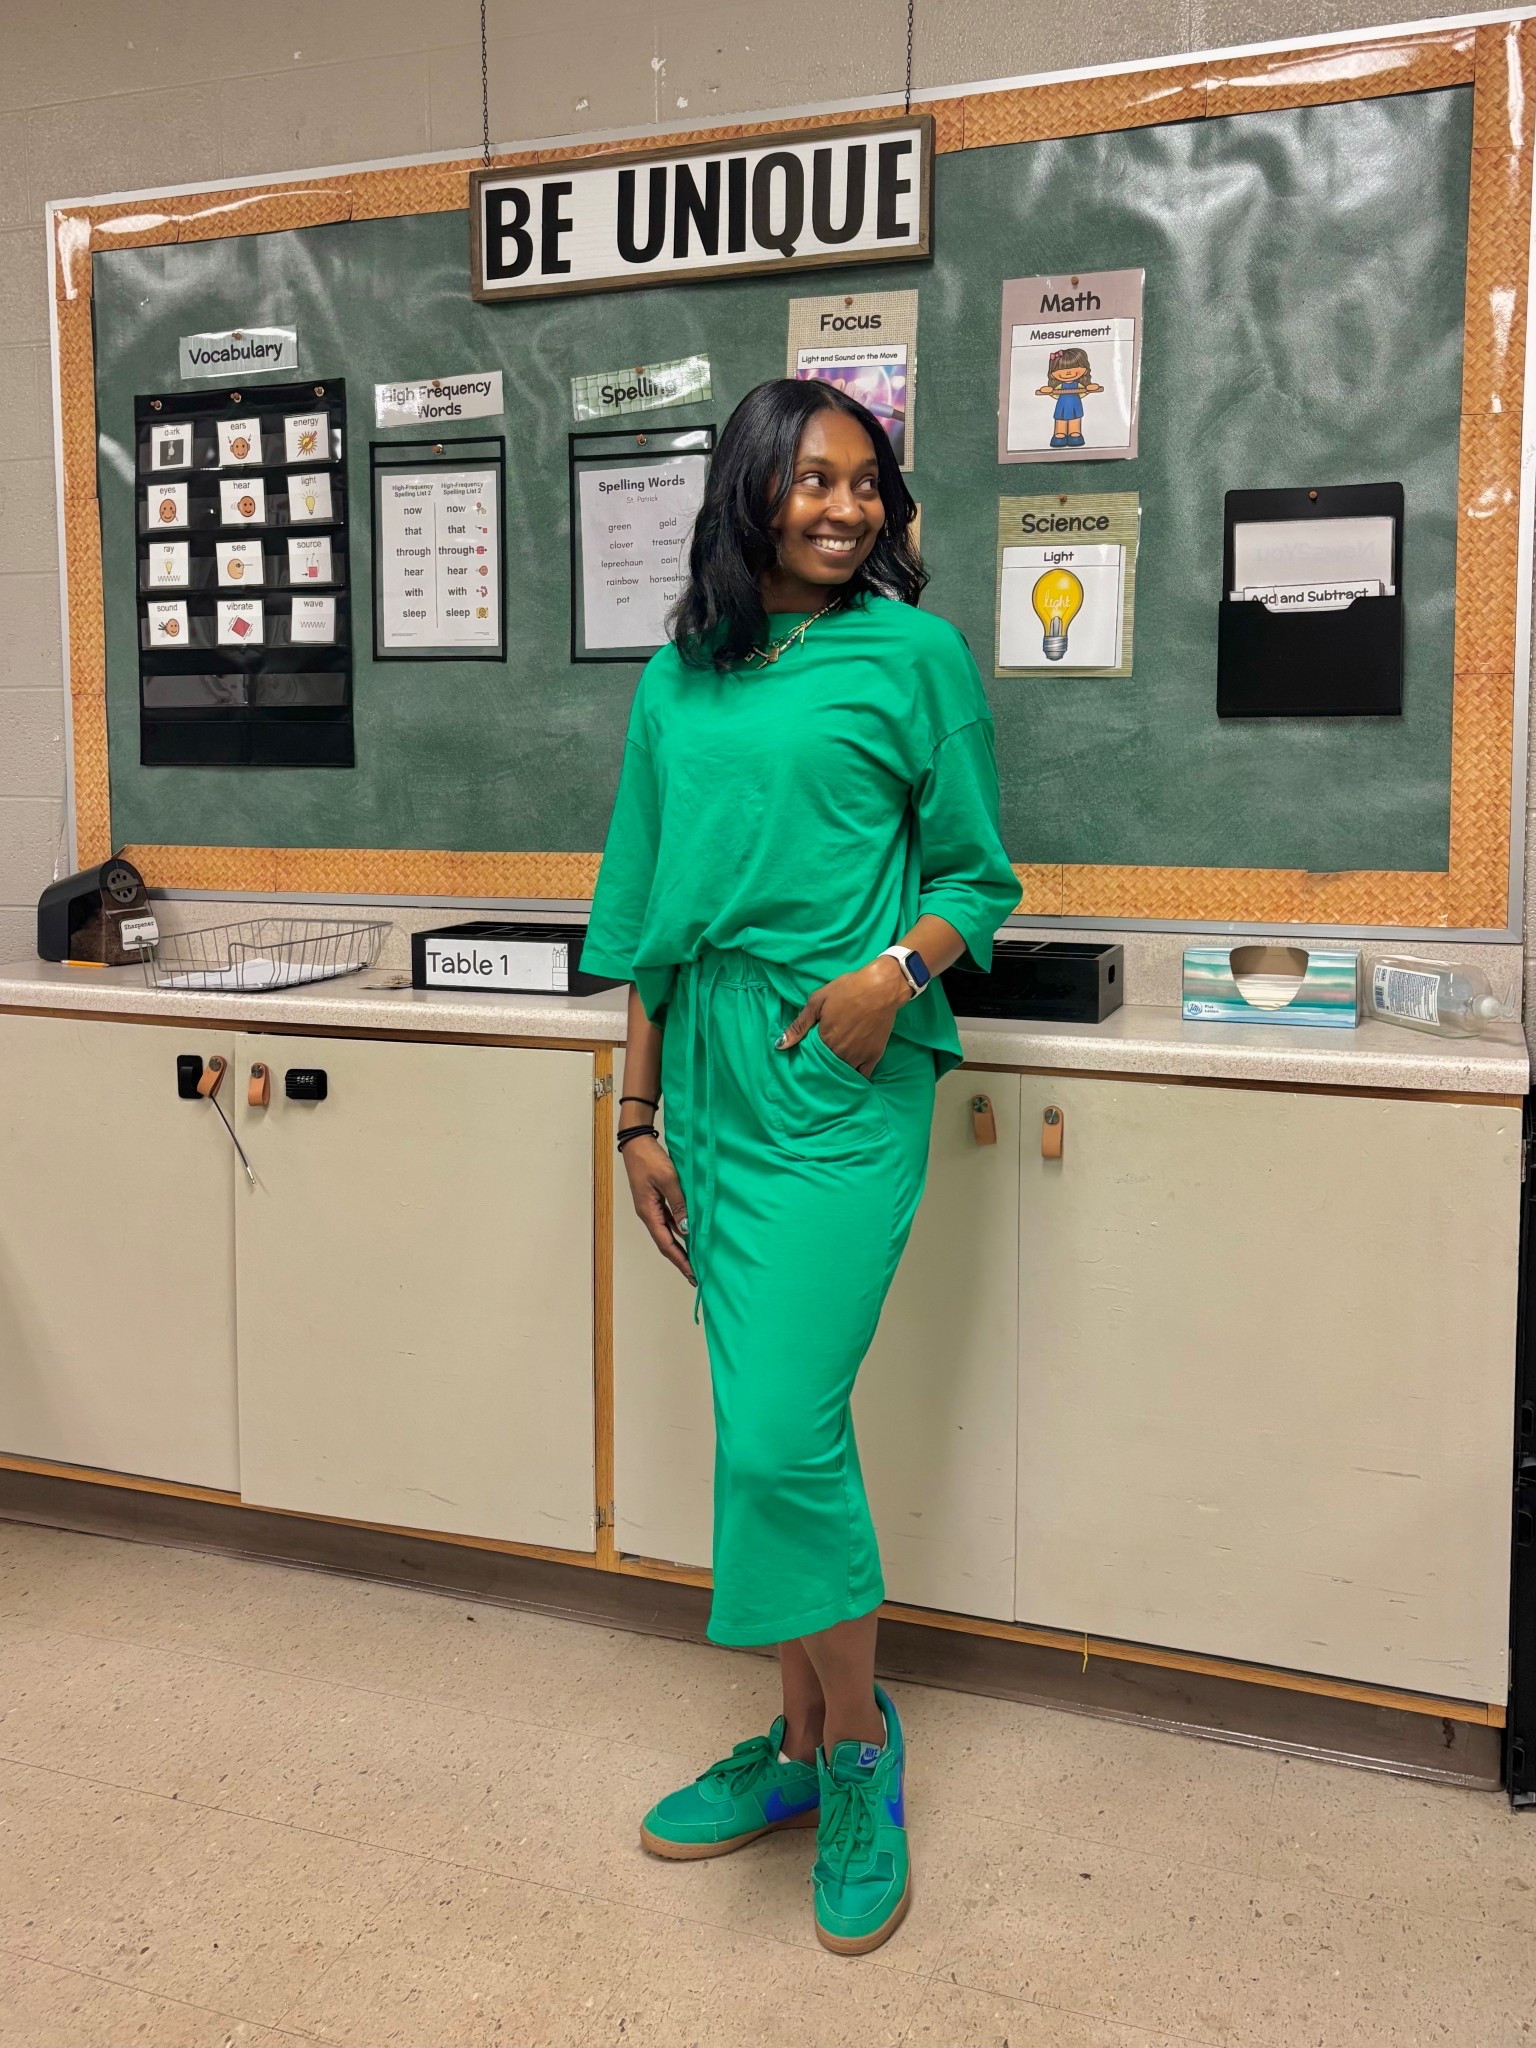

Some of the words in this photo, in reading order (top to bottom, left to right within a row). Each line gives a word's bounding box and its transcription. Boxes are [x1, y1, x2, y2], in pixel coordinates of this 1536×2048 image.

[485, 181, 573, 281] BE
[616, 140, 912, 264] UNIQUE
[1039, 291, 1101, 314] Math
[820, 313, 882, 331] Focus
[1030, 325, 1111, 341] Measurement
[189, 340, 282, 364] Vocabulary
[801, 356, 819, 364] Light
[835, 353, 855, 361] Sound
[867, 352, 878, 360] the
[382, 387, 415, 406] High
[419, 381, 491, 401] Frequency
[418, 402, 462, 419] Words
[230, 421, 246, 430] ears
[293, 417, 319, 427] energy
[164, 427, 180, 436] dark
[233, 481, 250, 490] hear
[301, 476, 317, 487] light
[441, 481, 484, 491] High-Frequency
[599, 479, 645, 494] Spelling
[648, 475, 685, 489] Words
[159, 486, 176, 495] eyes
[392, 484, 434, 492] High-Frequency
[443, 487, 465, 496] Spelling
[395, 490, 416, 498] Spelling
[447, 505, 466, 513] now
[608, 522, 632, 533] green
[659, 517, 677, 529] gold
[1022, 513, 1110, 534] Science
[405, 525, 422, 536] that
[447, 524, 466, 535] that
[231, 543, 247, 552] see
[297, 540, 322, 549] source
[610, 540, 634, 549] clover
[652, 538, 685, 546] treasure
[163, 545, 174, 555] ray
[396, 546, 431, 558] through
[438, 545, 474, 557] through
[661, 556, 678, 564] coin
[1043, 551, 1074, 564] Light
[601, 558, 644, 570] leprechaun
[404, 566, 424, 577] hear
[447, 565, 467, 576] hear
[606, 577, 640, 586] rainbow
[405, 587, 423, 598] with
[447, 586, 467, 597] with
[664, 593, 677, 601] hat
[1251, 592, 1278, 605] Add
[1281, 592, 1304, 604] and
[1307, 588, 1369, 602] Subtract
[303, 600, 324, 608] wave
[617, 596, 631, 606] pot
[1043, 589, 1071, 610] light
[157, 603, 178, 612] sound
[227, 602, 253, 611] vibrate
[402, 608, 427, 620] sleep
[446, 607, 470, 619] sleep
[124, 921, 154, 930] Sharpener
[427, 949, 493, 976] Table
[500, 954, 508, 976] 1
